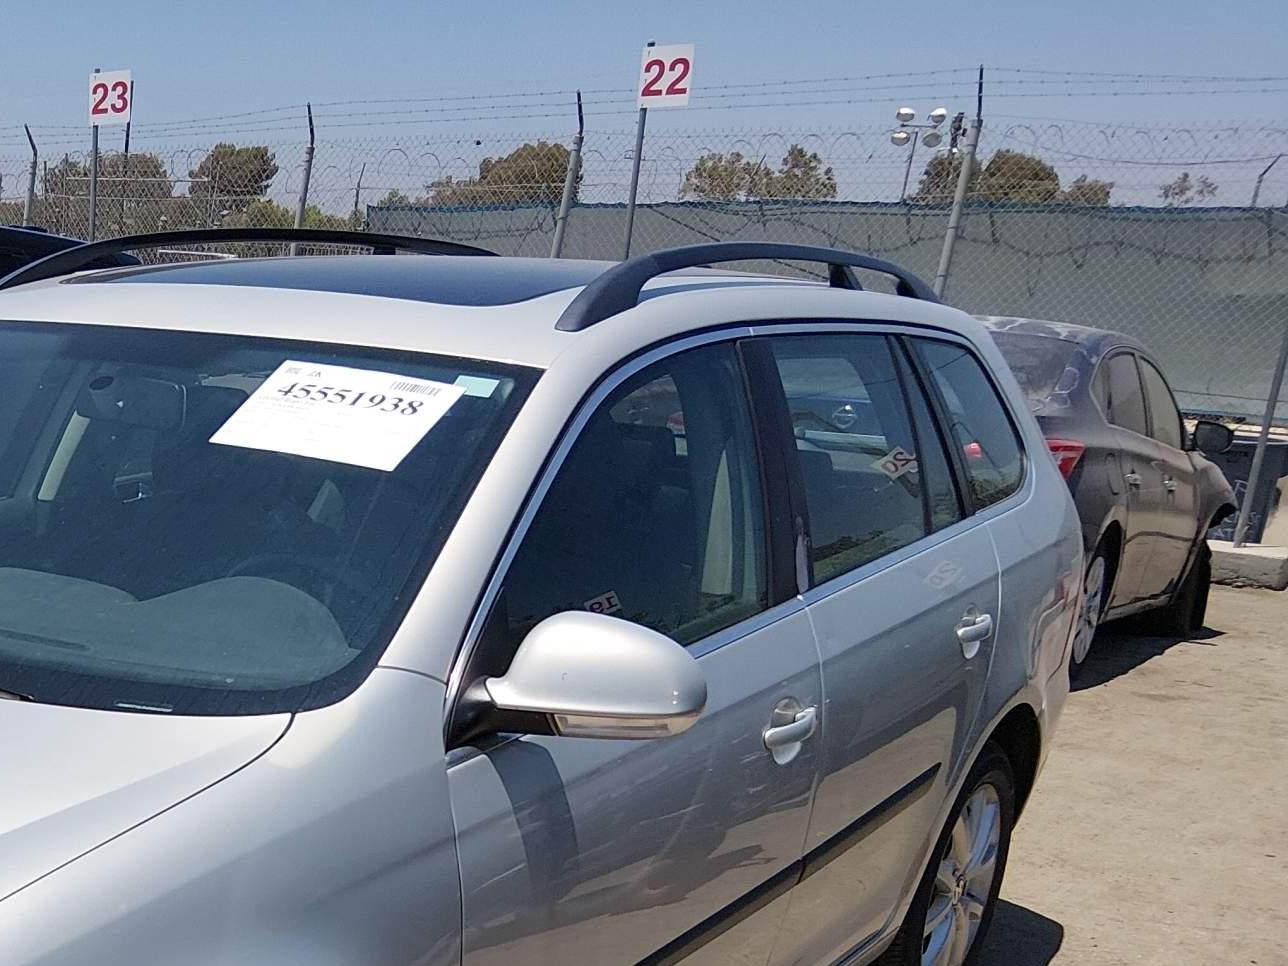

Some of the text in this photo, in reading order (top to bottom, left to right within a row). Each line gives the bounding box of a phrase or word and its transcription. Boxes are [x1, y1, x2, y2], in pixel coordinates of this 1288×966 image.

[641, 57, 690, 97] 22
[91, 80, 129, 115] 23
[277, 381, 425, 416] 45551938
